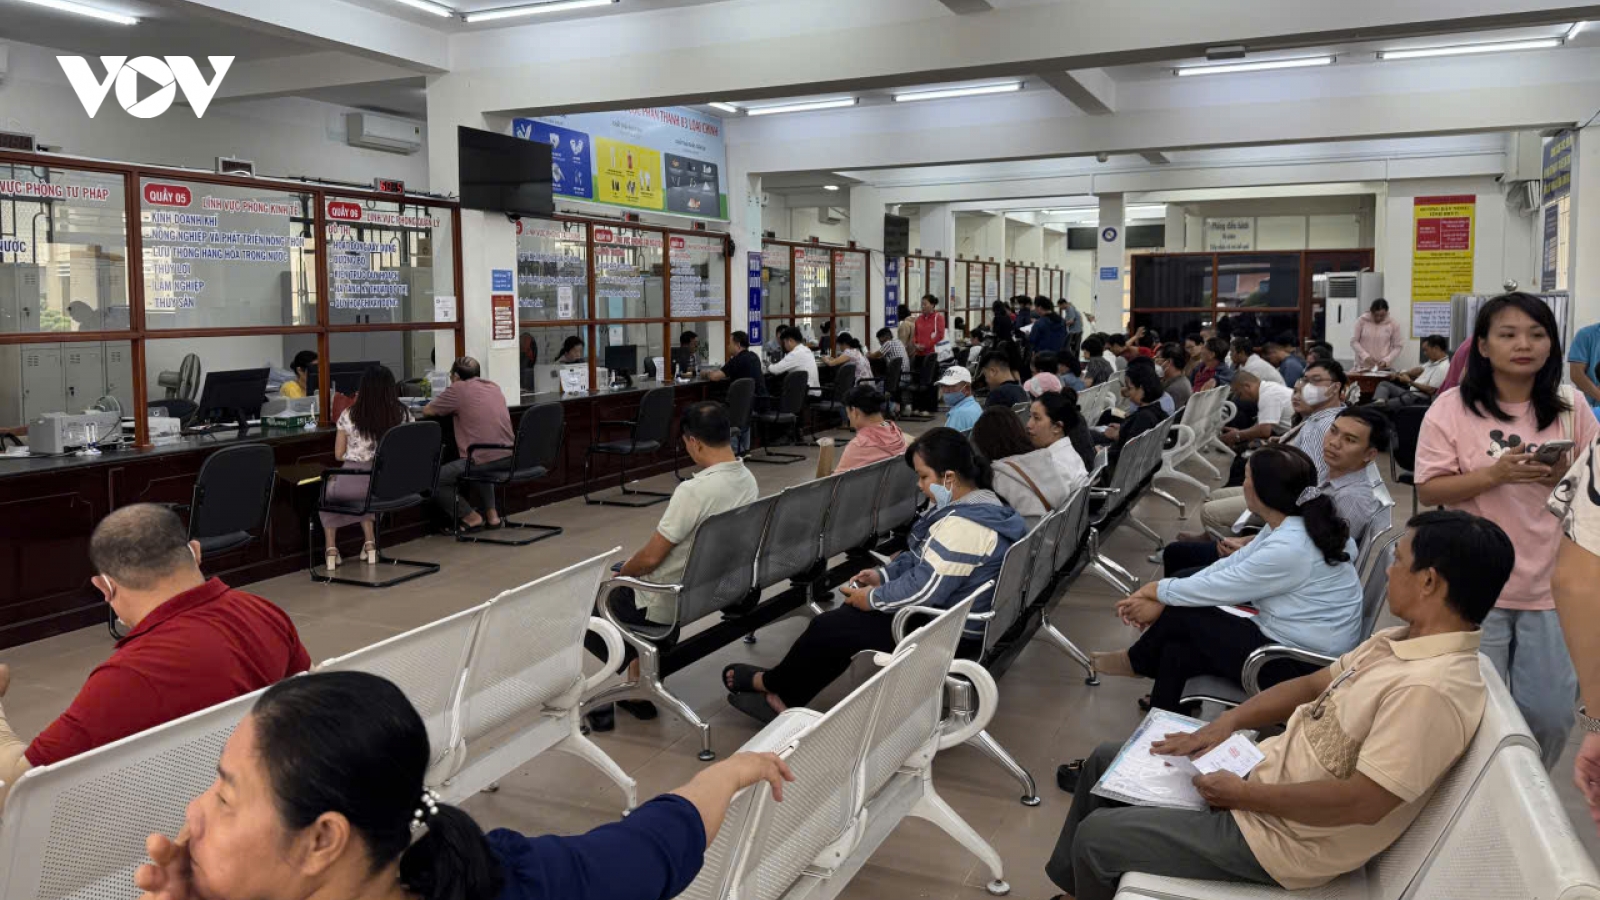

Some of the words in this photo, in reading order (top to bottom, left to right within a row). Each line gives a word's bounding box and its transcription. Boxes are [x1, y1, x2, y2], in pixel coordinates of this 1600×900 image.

[25, 180, 62, 197] PHÒNG
[65, 185, 79, 198] TƯ
[82, 184, 109, 200] PHÁP
[175, 192, 186, 204] 05
[270, 203, 288, 216] KINH
[152, 211, 171, 223] KINH
[174, 213, 201, 226] DOANH
